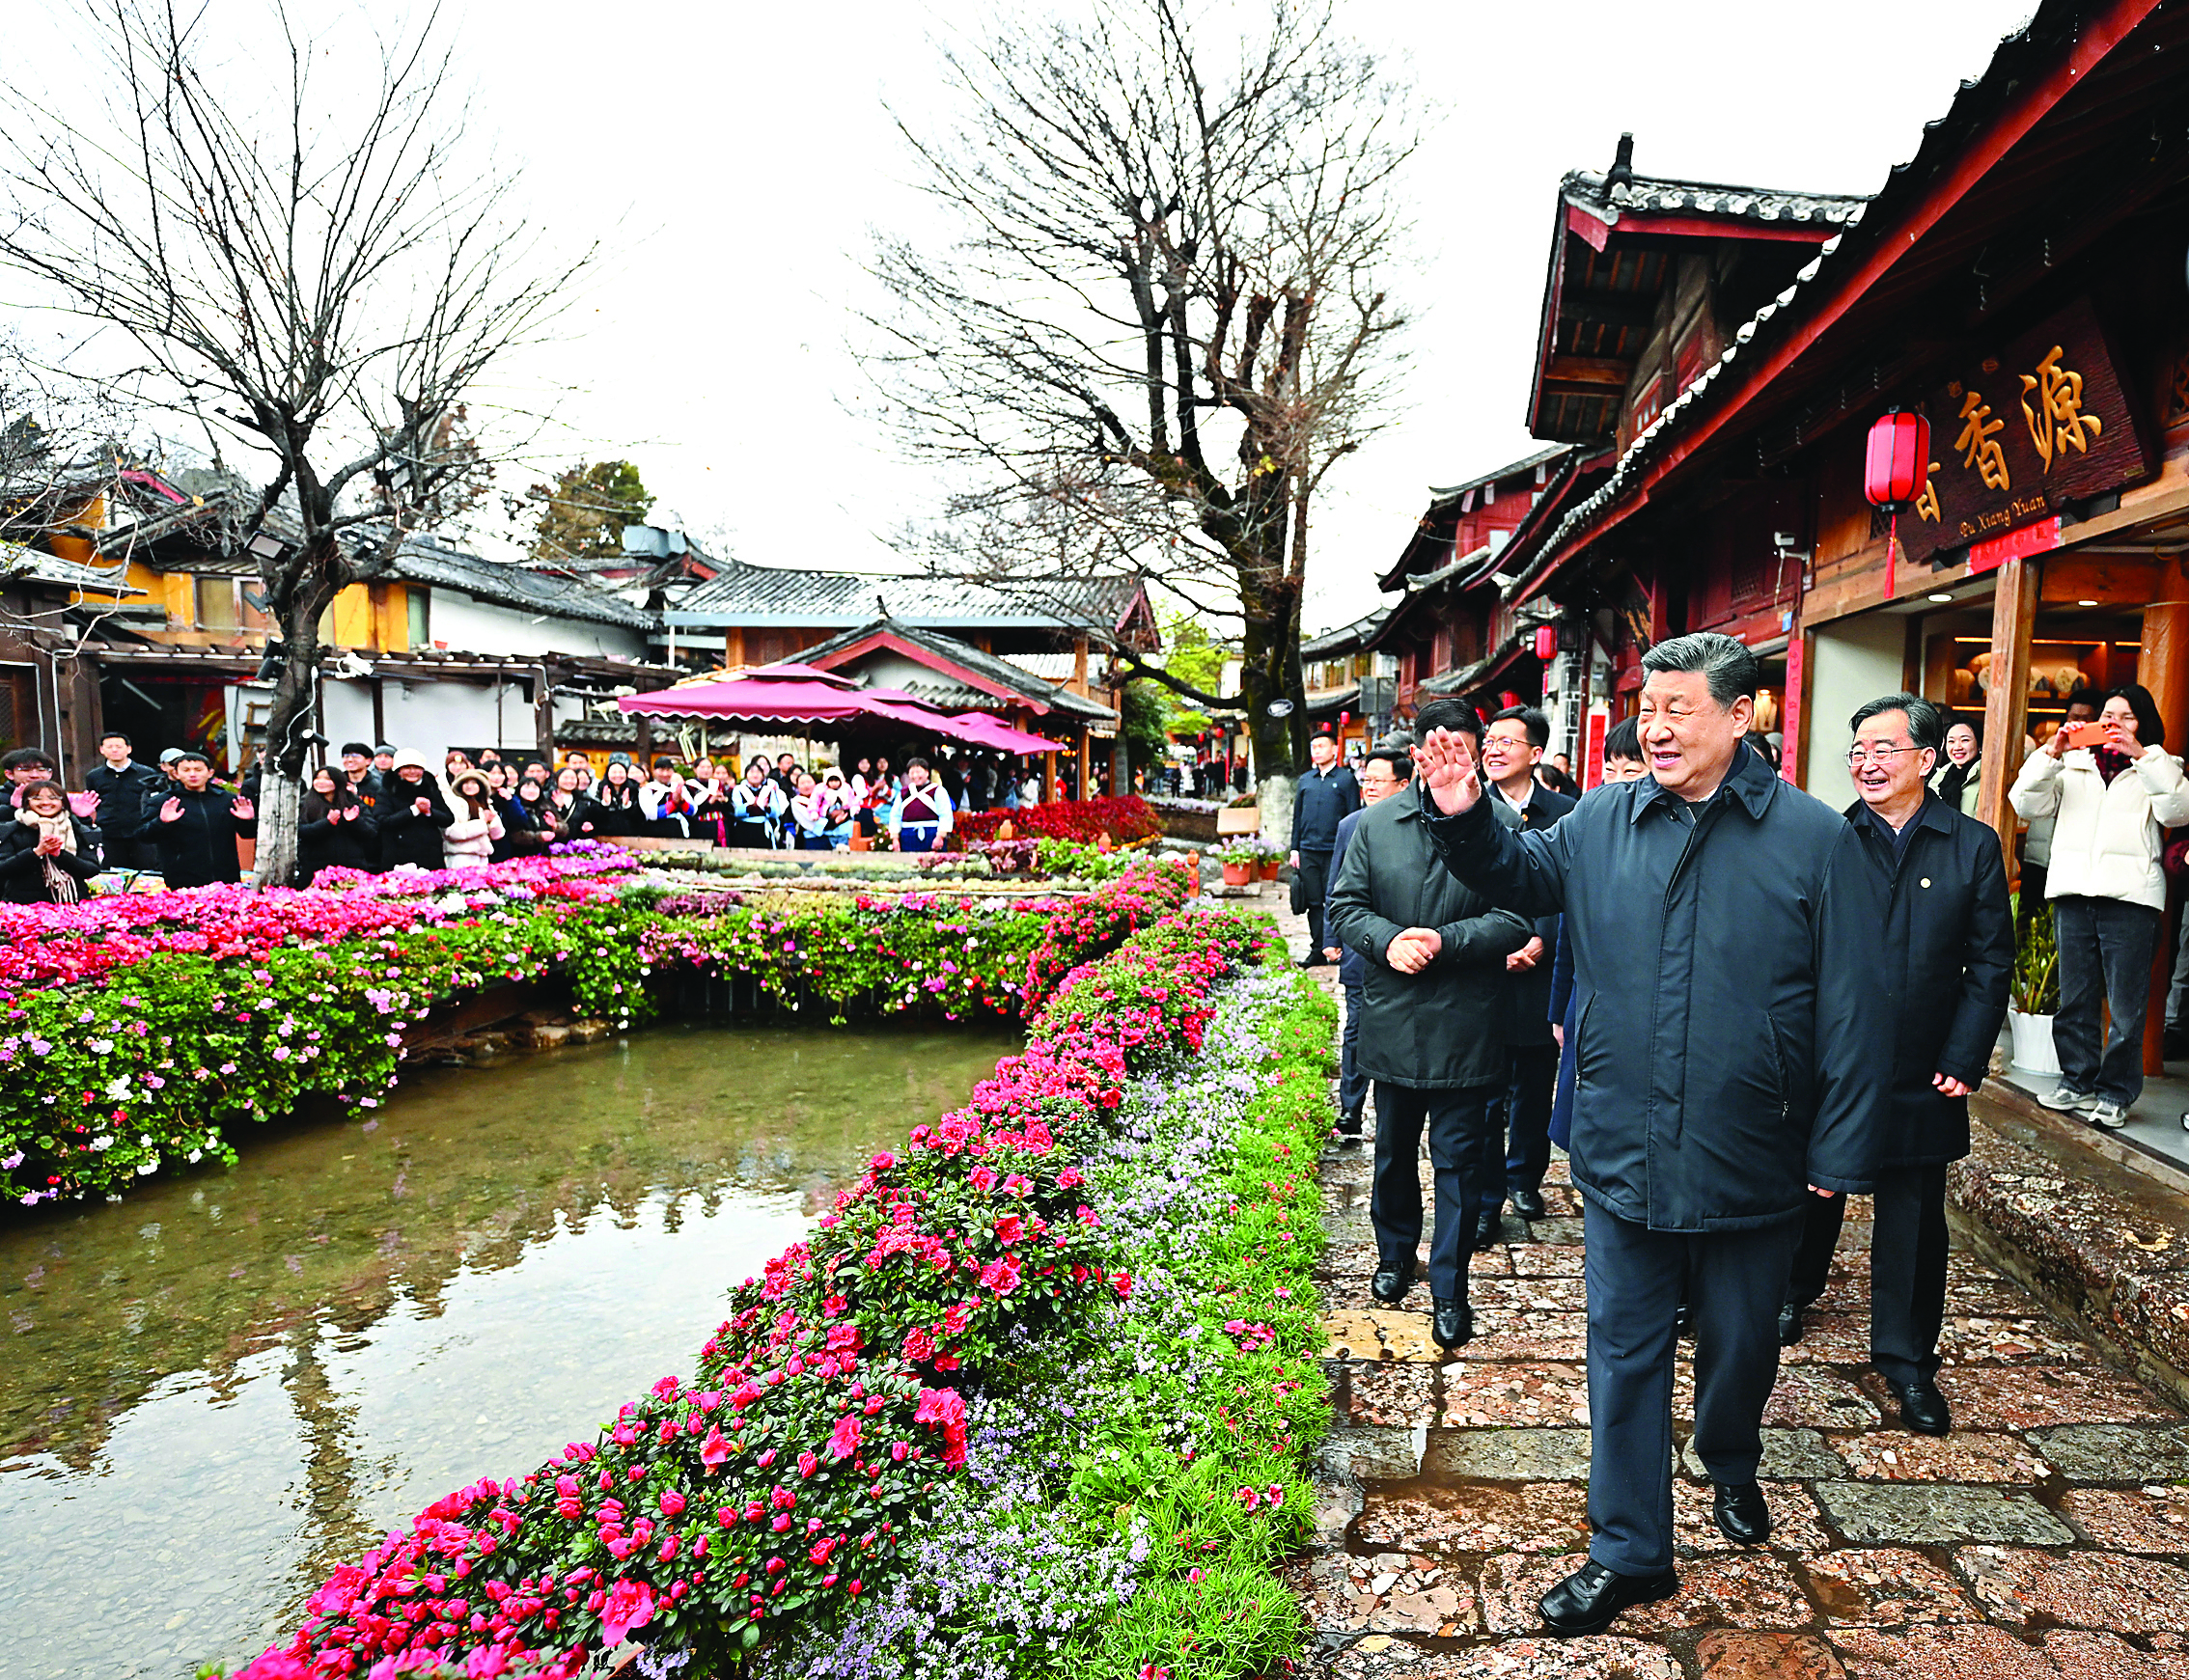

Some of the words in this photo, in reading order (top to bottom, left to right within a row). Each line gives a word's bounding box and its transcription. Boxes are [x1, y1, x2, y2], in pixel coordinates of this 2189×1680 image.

[1959, 521, 1976, 537] Pu
[1977, 509, 2011, 533] Xiang
[2011, 495, 2045, 517] Yuan
